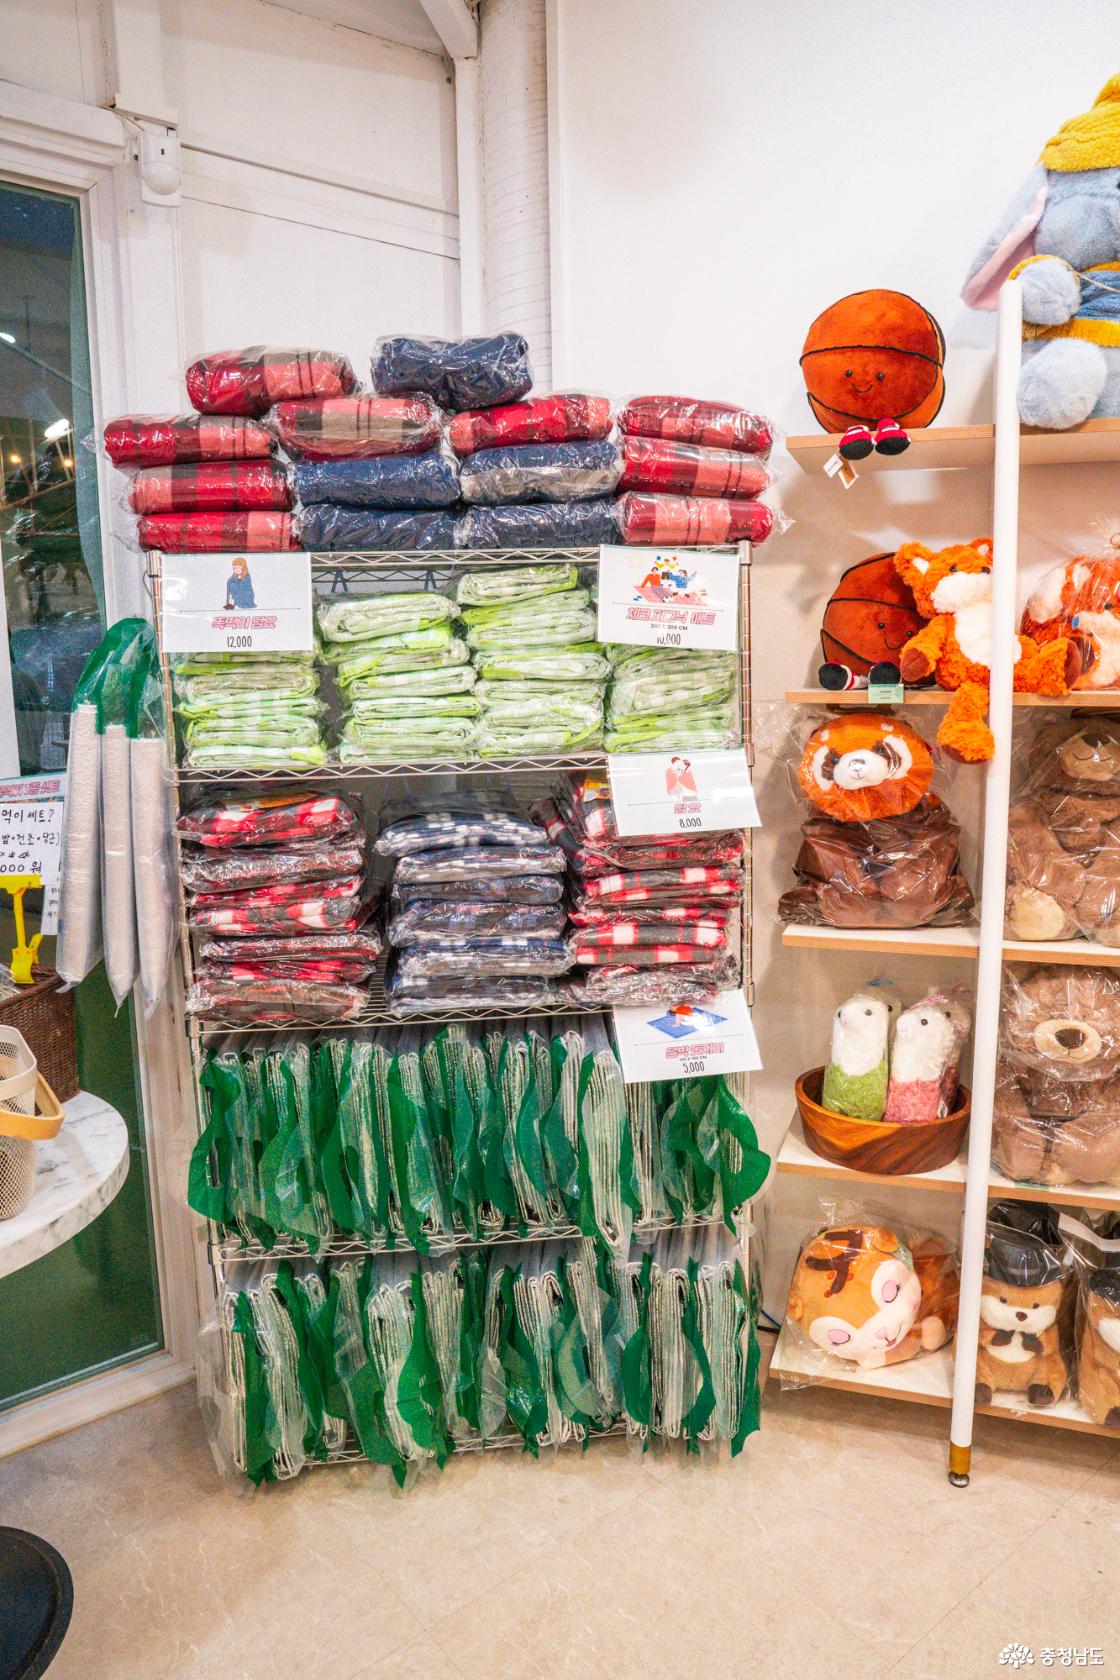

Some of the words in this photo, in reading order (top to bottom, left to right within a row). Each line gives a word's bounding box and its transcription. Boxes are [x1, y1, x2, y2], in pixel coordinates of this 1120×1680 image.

[251, 616, 277, 629] 담요
[227, 635, 252, 648] 12,000
[683, 1061, 705, 1074] 5,000
